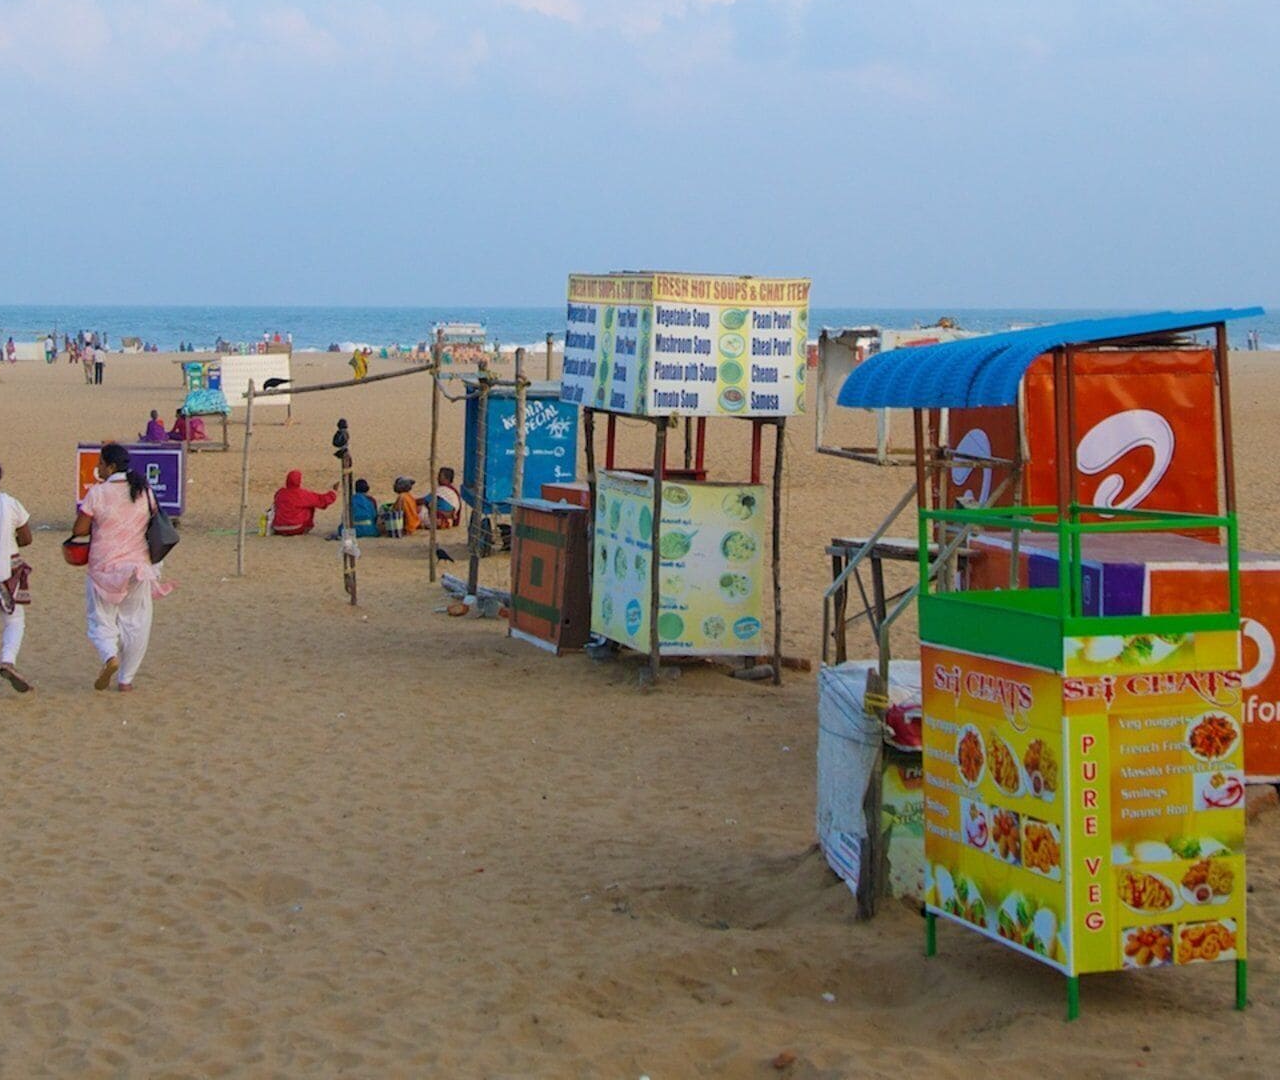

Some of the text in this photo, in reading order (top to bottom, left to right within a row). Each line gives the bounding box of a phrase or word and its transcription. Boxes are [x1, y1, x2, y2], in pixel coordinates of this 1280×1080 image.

[657, 276, 688, 297] FRESH
[691, 279, 711, 298] HOT
[714, 280, 748, 300] SOUPS
[759, 282, 785, 301] CHAT
[655, 306, 710, 328] Vegetable Soup
[655, 333, 711, 355] Mushroom Soup
[654, 361, 682, 381] Plantain
[700, 363, 717, 382] Soup
[654, 389, 698, 409] Tomato Soup
[751, 391, 779, 410] Samosa
[934, 663, 1033, 732] Sri CHATS
[1064, 670, 1242, 710] Sri CHATS
[1081, 735, 1098, 835] PURE
[1085, 857, 1105, 931] VEG
